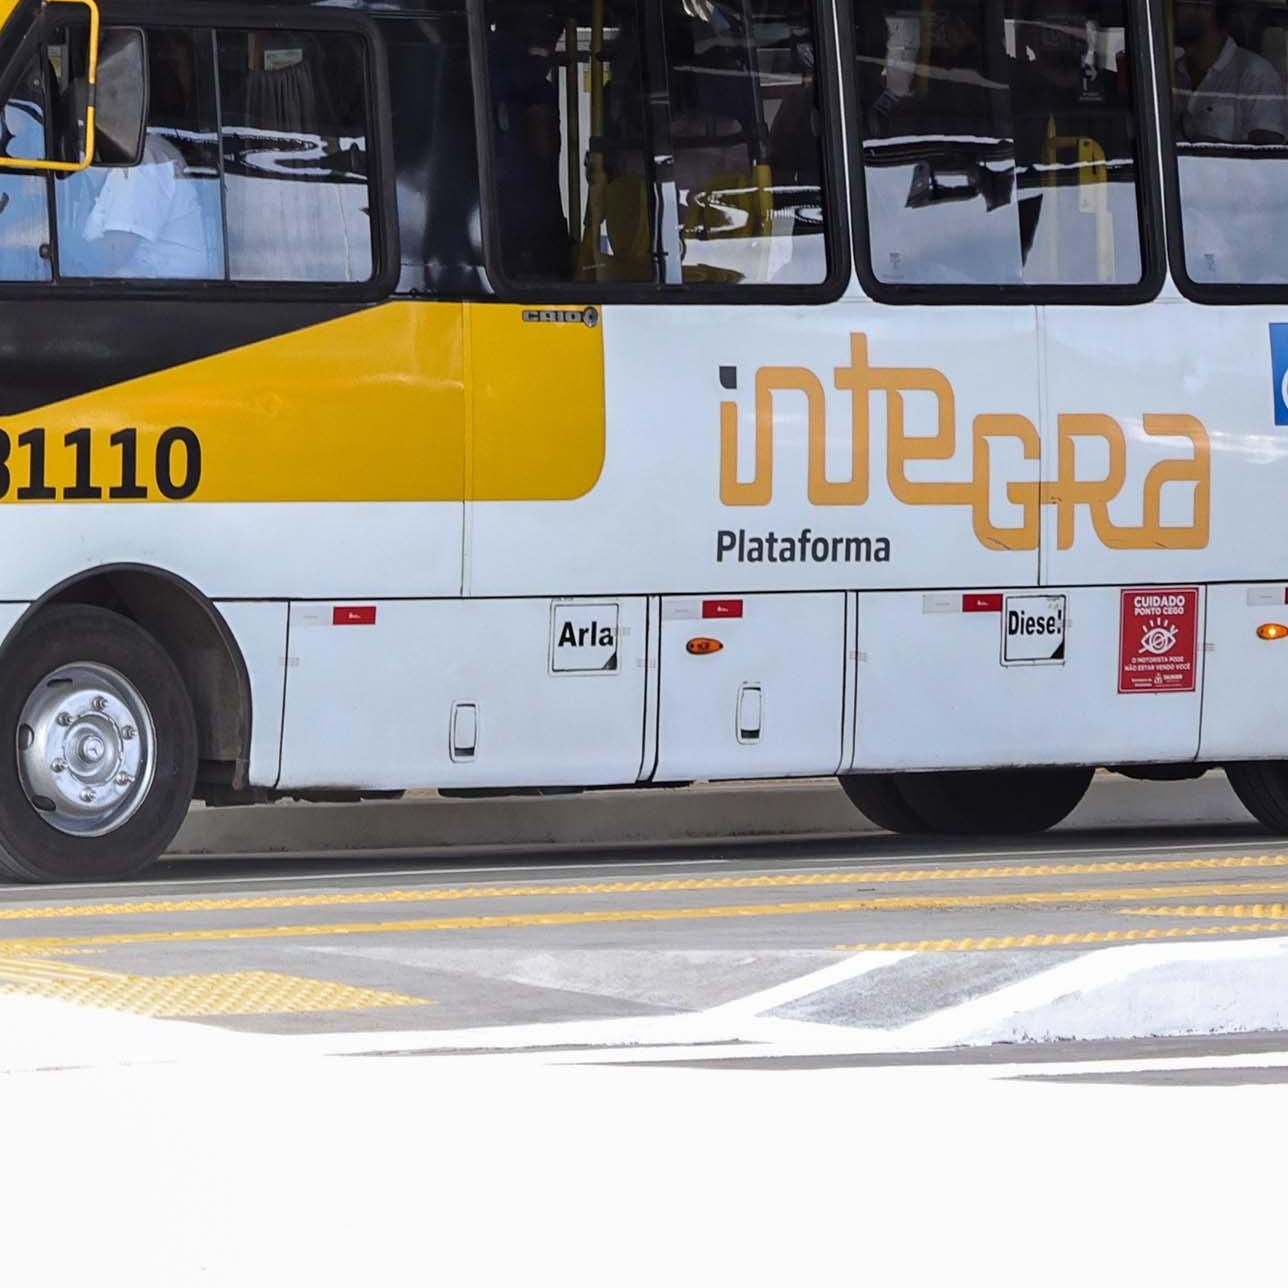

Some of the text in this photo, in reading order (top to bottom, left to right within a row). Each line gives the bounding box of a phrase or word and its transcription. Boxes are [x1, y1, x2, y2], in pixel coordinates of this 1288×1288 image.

[522, 310, 584, 322] CAIO
[716, 529, 891, 562] Plataforma
[1134, 596, 1185, 607] CUIDADO
[1134, 606, 1184, 616] PONTO CEGO
[558, 621, 614, 647] Arla
